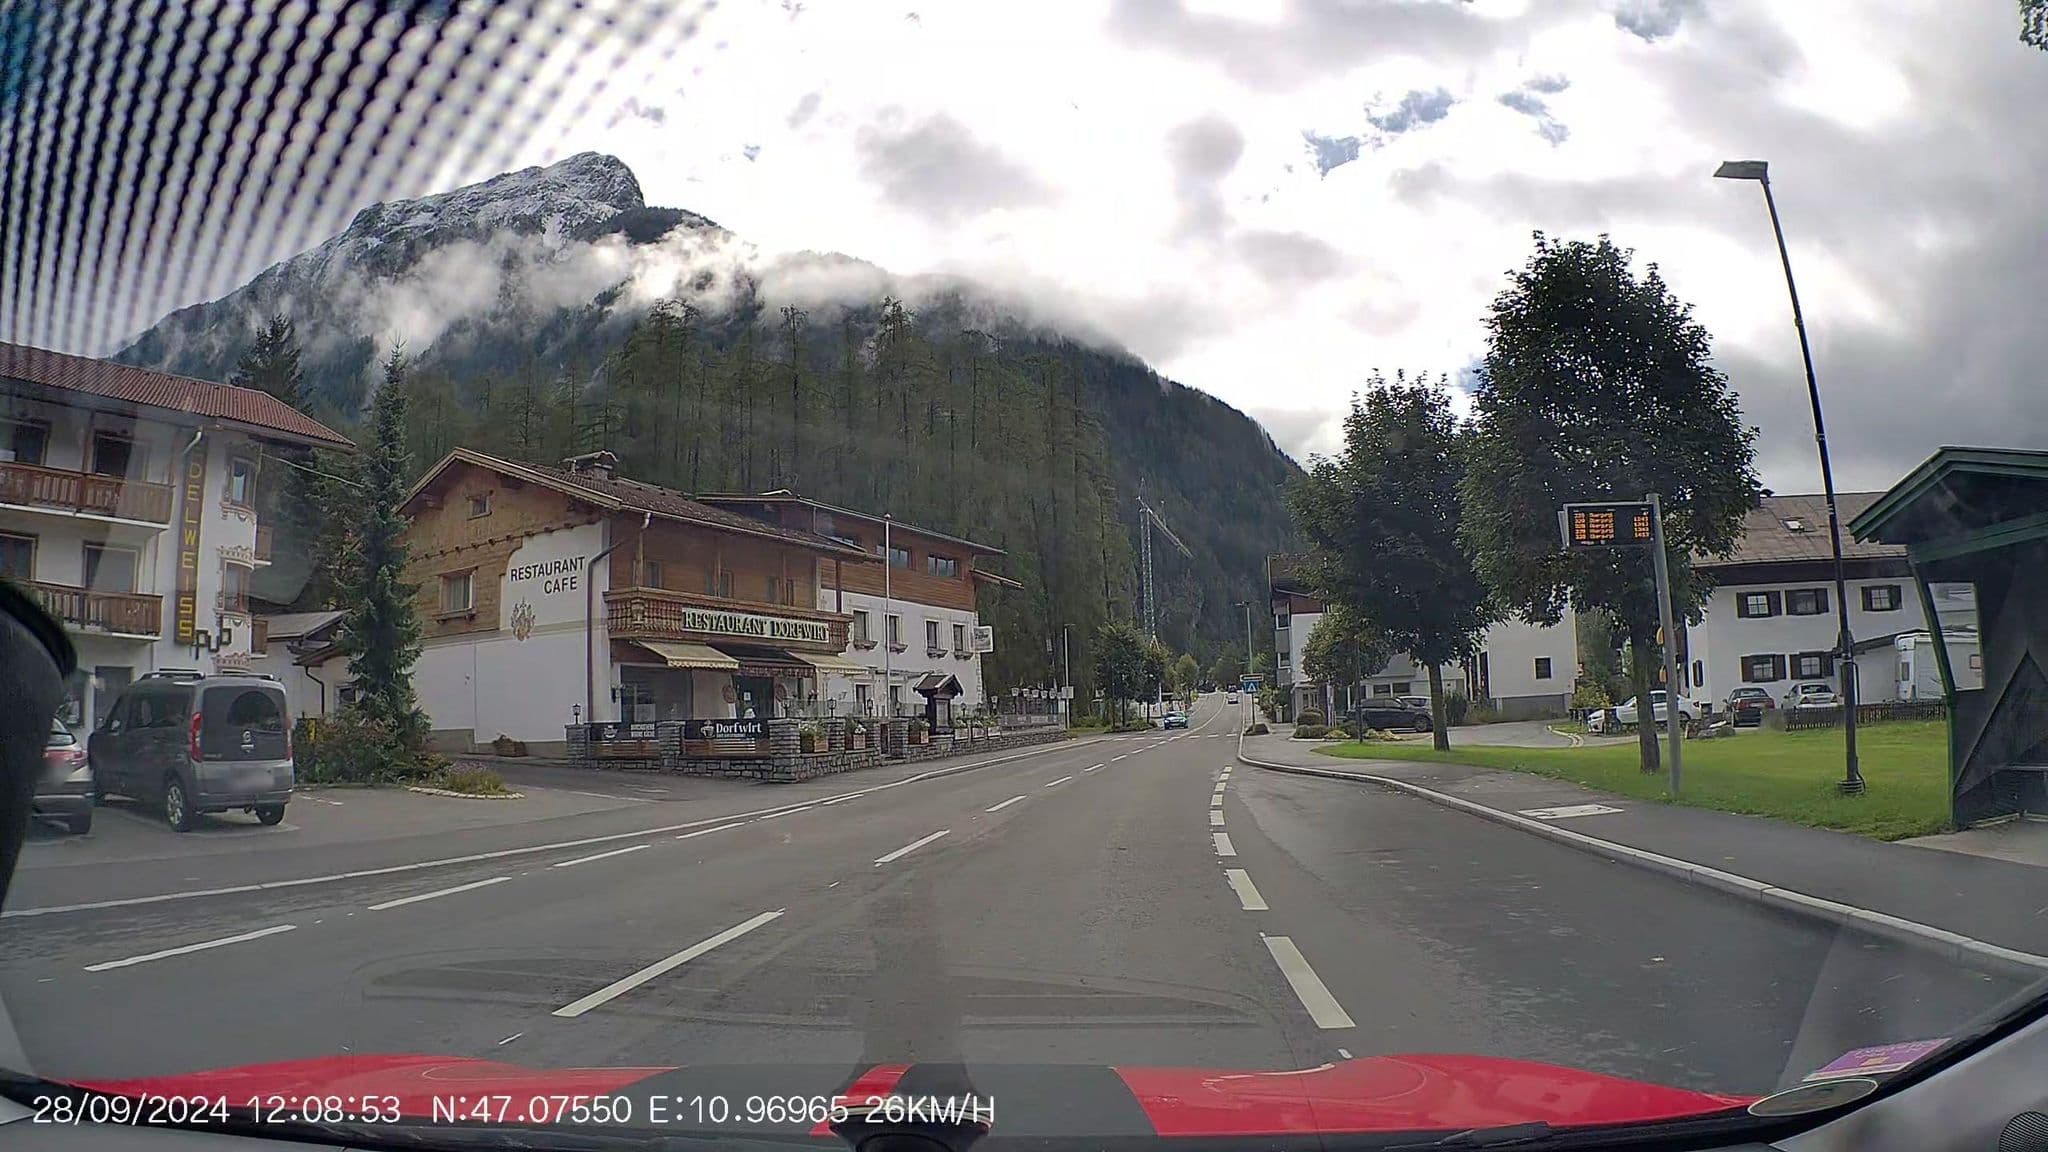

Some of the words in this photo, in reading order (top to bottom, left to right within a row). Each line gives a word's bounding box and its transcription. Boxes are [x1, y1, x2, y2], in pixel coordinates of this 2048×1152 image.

[511, 556, 585, 581] RESTAURANT
[544, 576, 577, 594] CAFE
[683, 611, 767, 636] RESTAURANT
[771, 620, 829, 641] DORFWIRT
